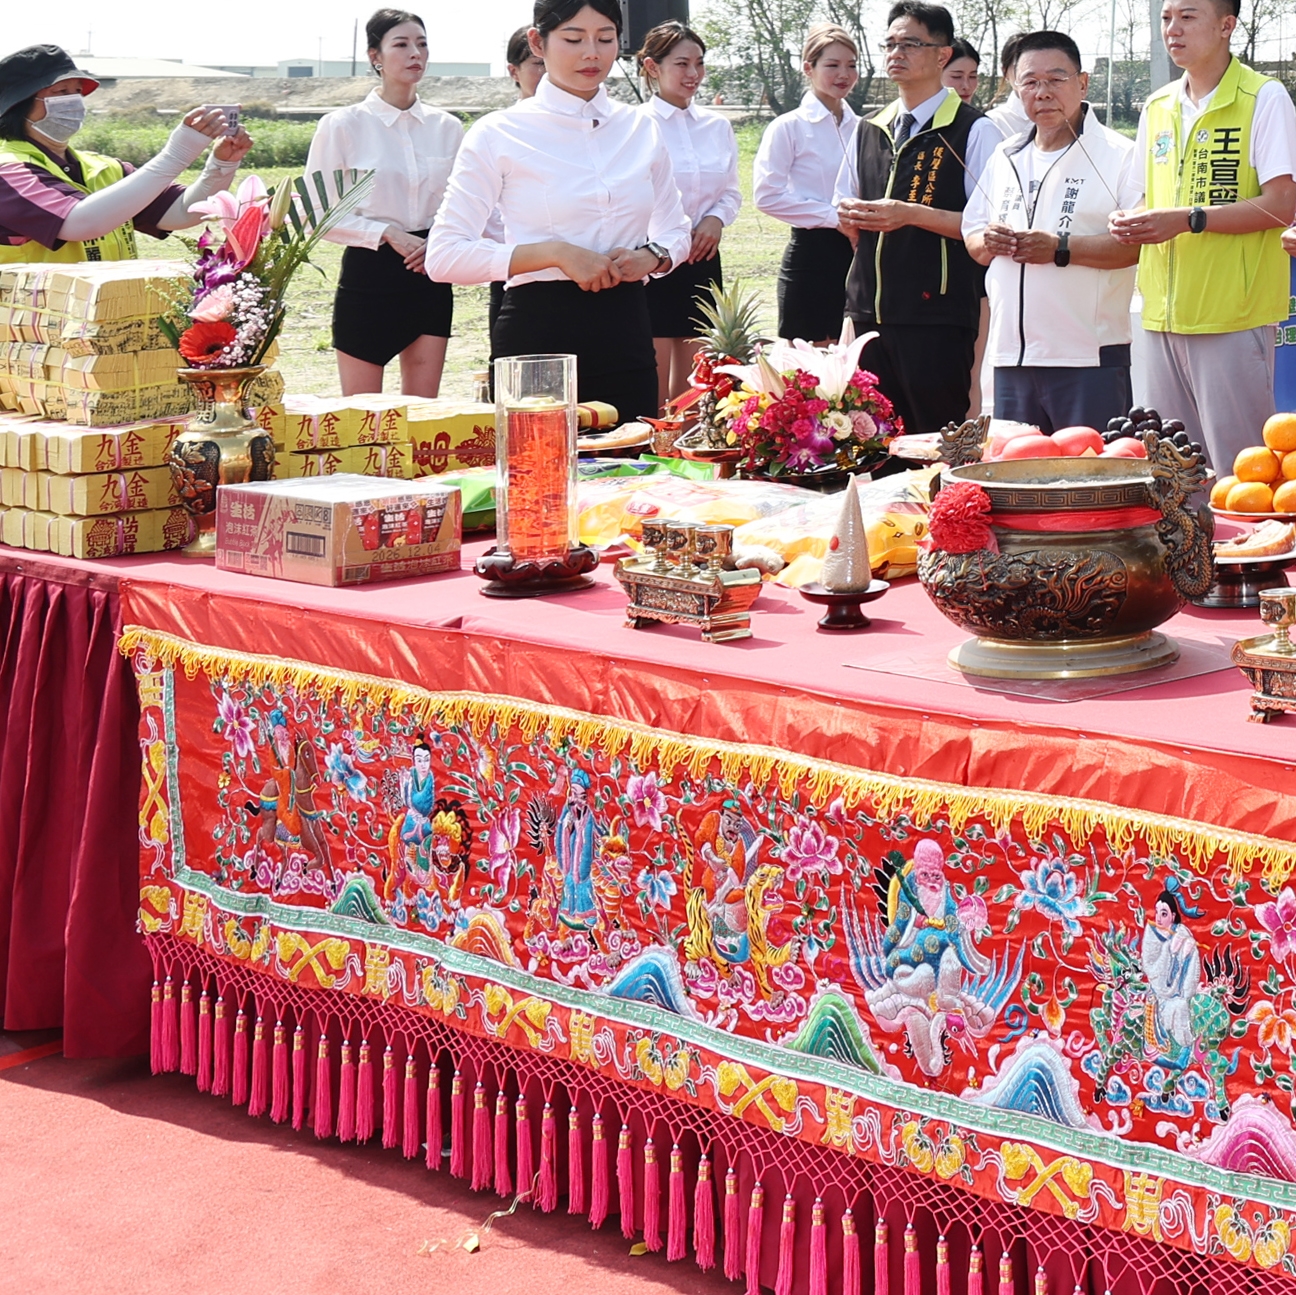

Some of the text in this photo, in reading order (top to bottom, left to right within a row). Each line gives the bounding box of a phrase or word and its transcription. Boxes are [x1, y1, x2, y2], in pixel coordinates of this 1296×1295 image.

[95, 431, 146, 461] 九金
[100, 471, 149, 503] 九金
[230, 501, 256, 520] 生活
[372, 544, 441, 562] 2026.12.04
